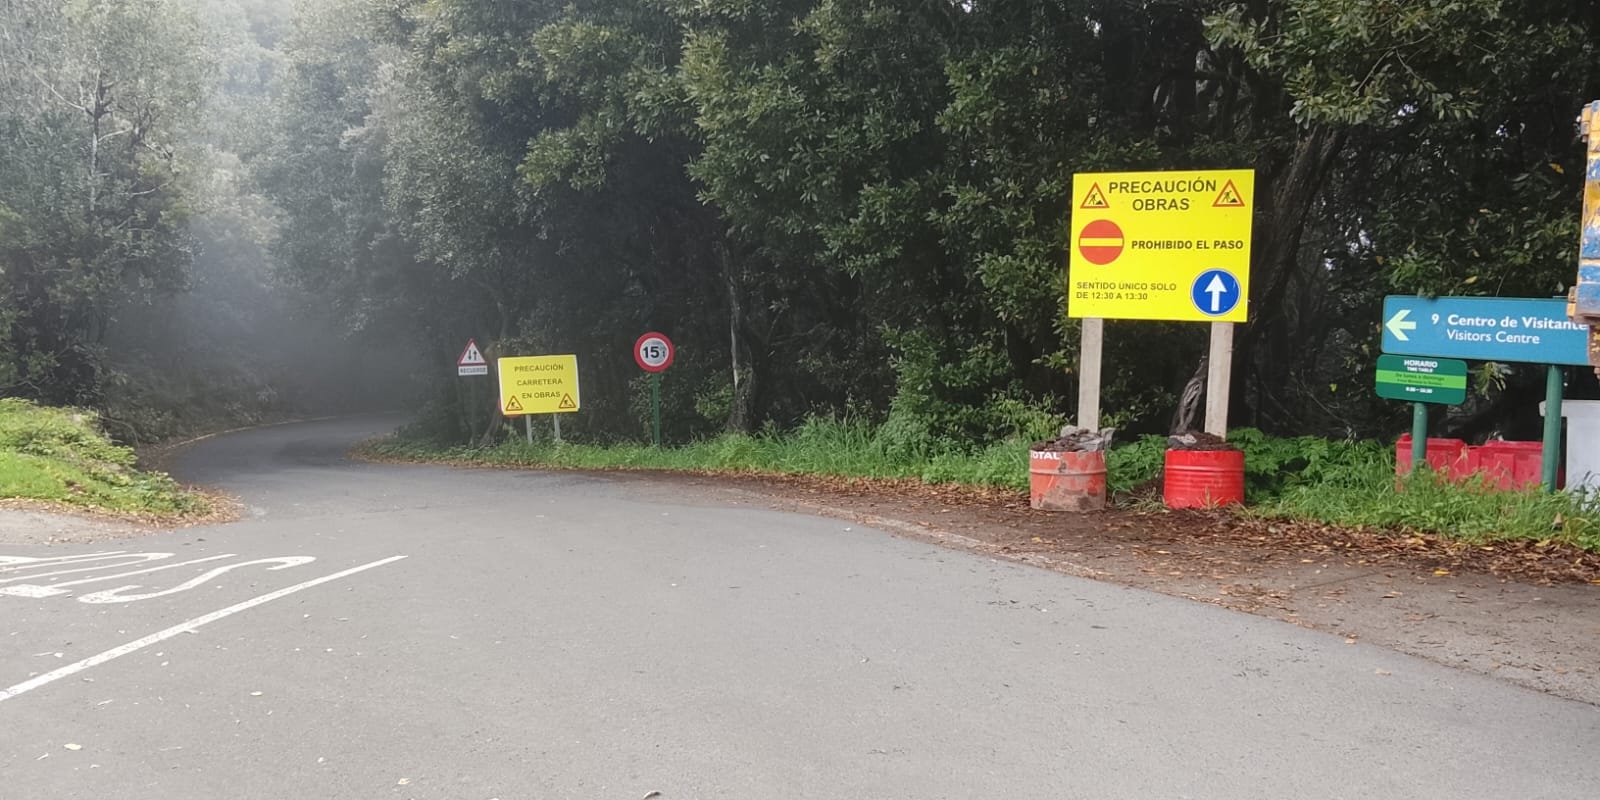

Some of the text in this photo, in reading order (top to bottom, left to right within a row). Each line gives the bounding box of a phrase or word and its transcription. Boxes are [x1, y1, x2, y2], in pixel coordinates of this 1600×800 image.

[1109, 176, 1217, 194] PRECAUCIÓN
[1132, 198, 1190, 212] OBRAS
[1131, 240, 1244, 250] PROHIBIDO EL PASO
[1076, 281, 1116, 290] SENTIDO
[1150, 282, 1177, 291] SOLO
[1076, 291, 1148, 300] DE 12:30 A 13:30
[1431, 315, 1439, 325] 9
[1447, 314, 1497, 327] Centro
[1500, 315, 1518, 328] de
[1446, 329, 1541, 344] Visitors Centre
[643, 346, 660, 359] 15
[514, 362, 564, 373] PRECAUCIÓN
[1403, 359, 1438, 368] HORARIO
[516, 378, 563, 386] CARRETERA
[534, 391, 561, 399] OBRAS
